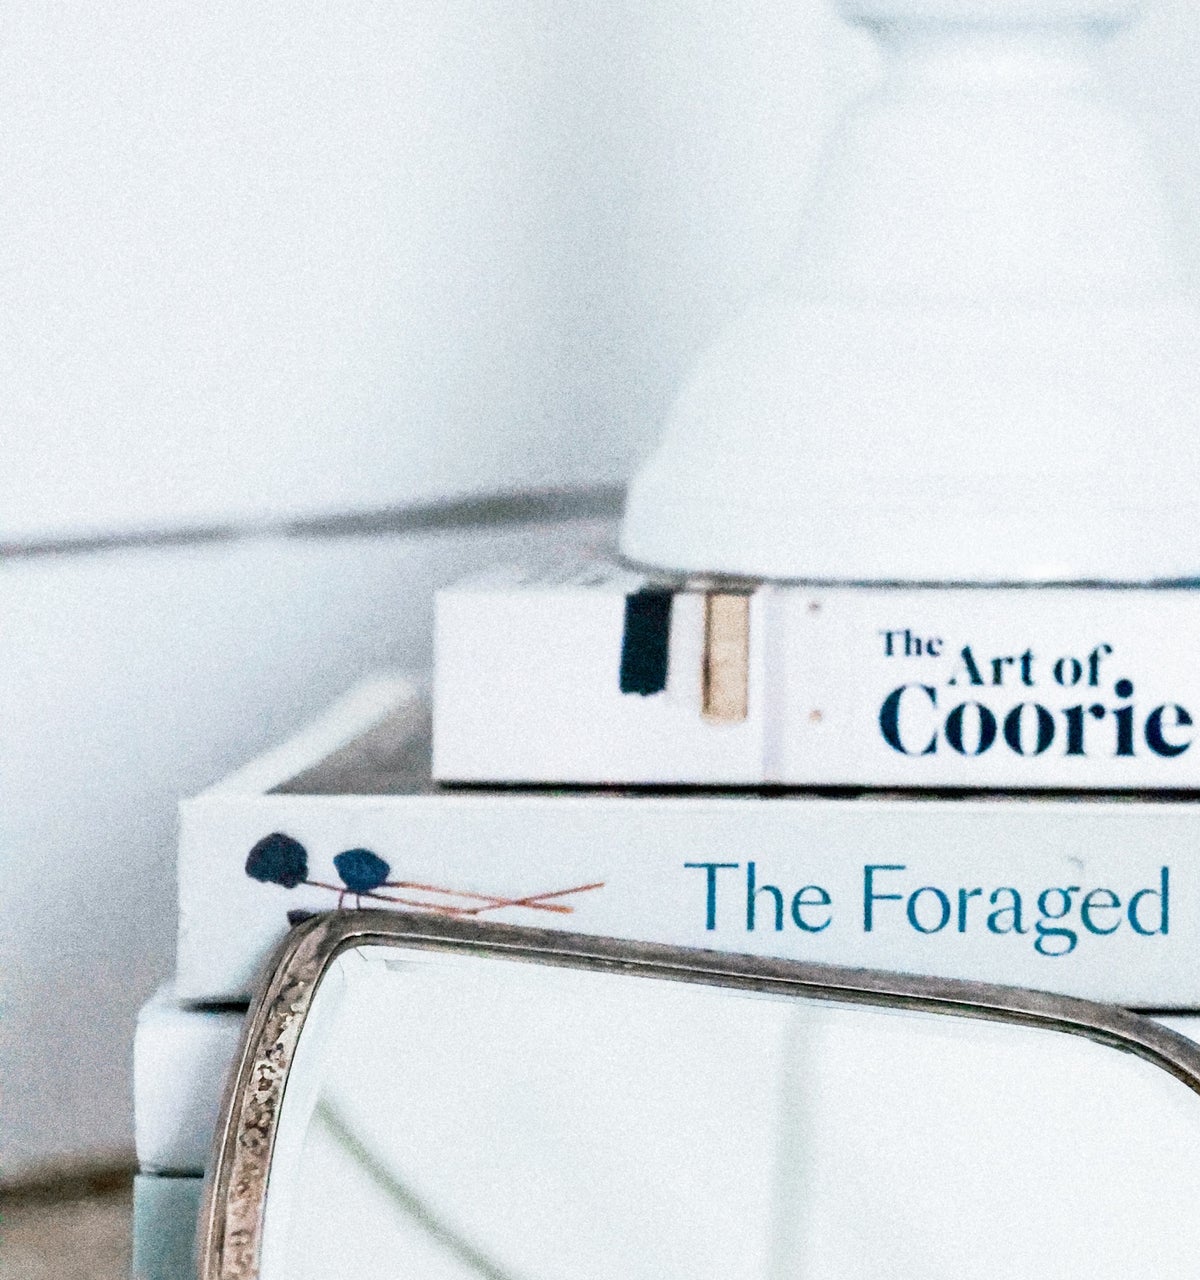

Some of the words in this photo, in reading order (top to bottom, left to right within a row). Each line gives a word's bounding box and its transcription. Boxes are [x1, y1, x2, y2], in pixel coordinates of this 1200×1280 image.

[879, 628, 944, 658] The
[947, 644, 1035, 688] Art
[1052, 642, 1112, 688] of
[877, 678, 1194, 759] Coorie
[683, 860, 833, 935] The
[863, 864, 1170, 956] Foraged
